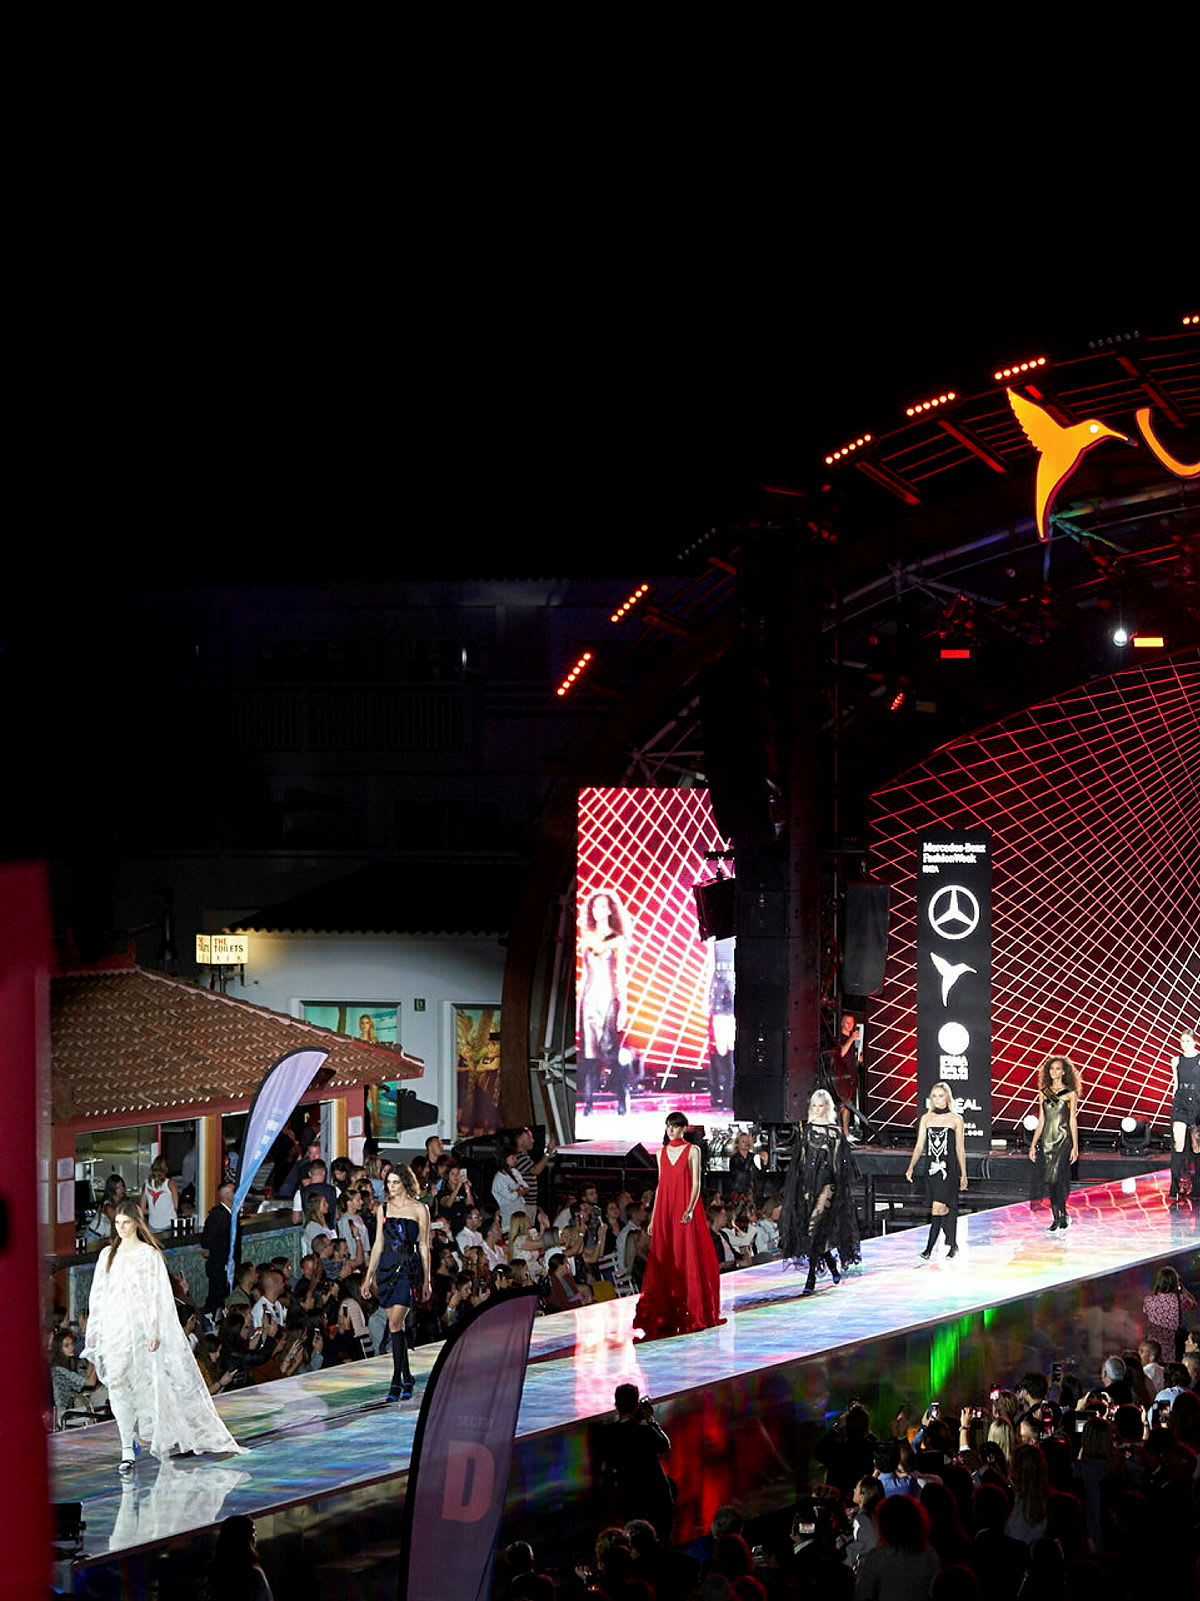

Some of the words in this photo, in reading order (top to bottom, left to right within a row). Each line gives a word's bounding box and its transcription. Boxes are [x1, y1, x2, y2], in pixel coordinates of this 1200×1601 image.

[214, 937, 226, 945] THE
[214, 945, 244, 953] TOILETS
[441, 1439, 496, 1523] D
